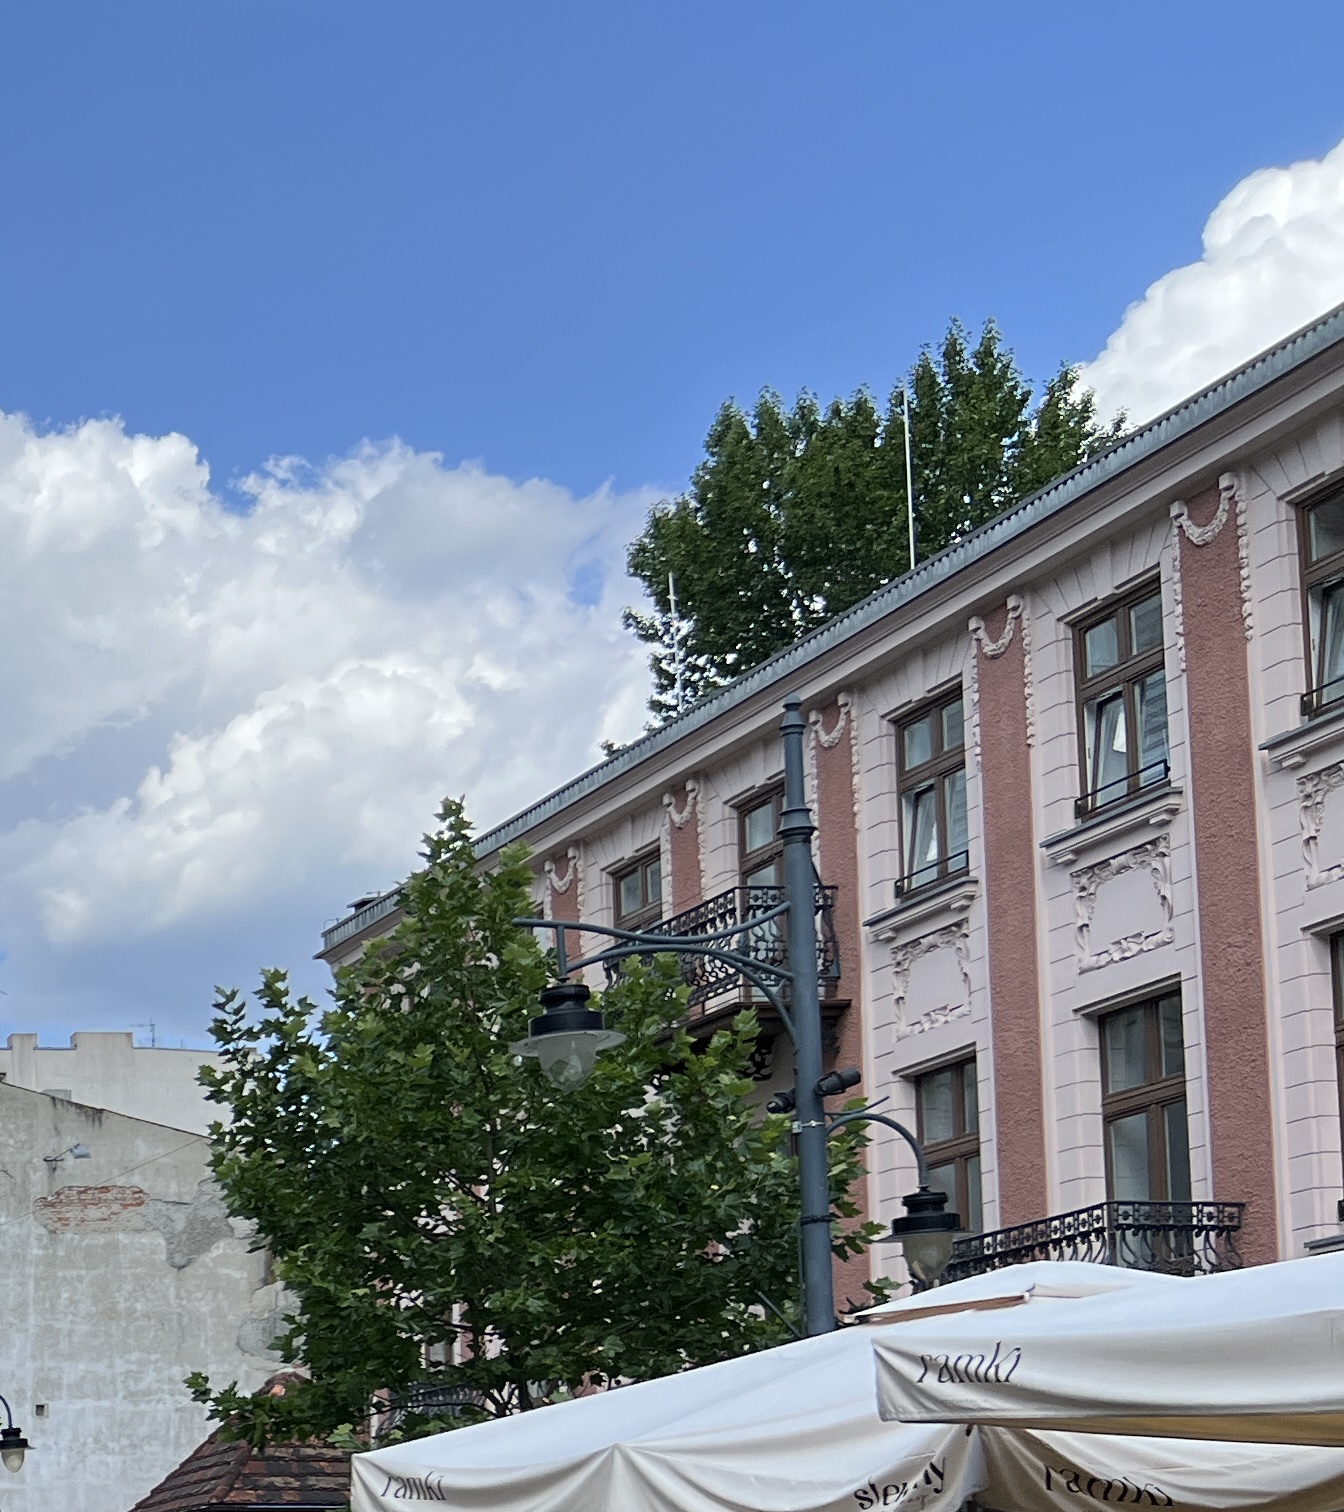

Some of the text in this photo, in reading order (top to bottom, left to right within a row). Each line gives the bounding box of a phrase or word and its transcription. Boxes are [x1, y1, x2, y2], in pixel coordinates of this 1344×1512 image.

[916, 1341, 1022, 1384] ramki
[380, 1470, 448, 1502] ramki
[1043, 1462, 1175, 1509] ramki
